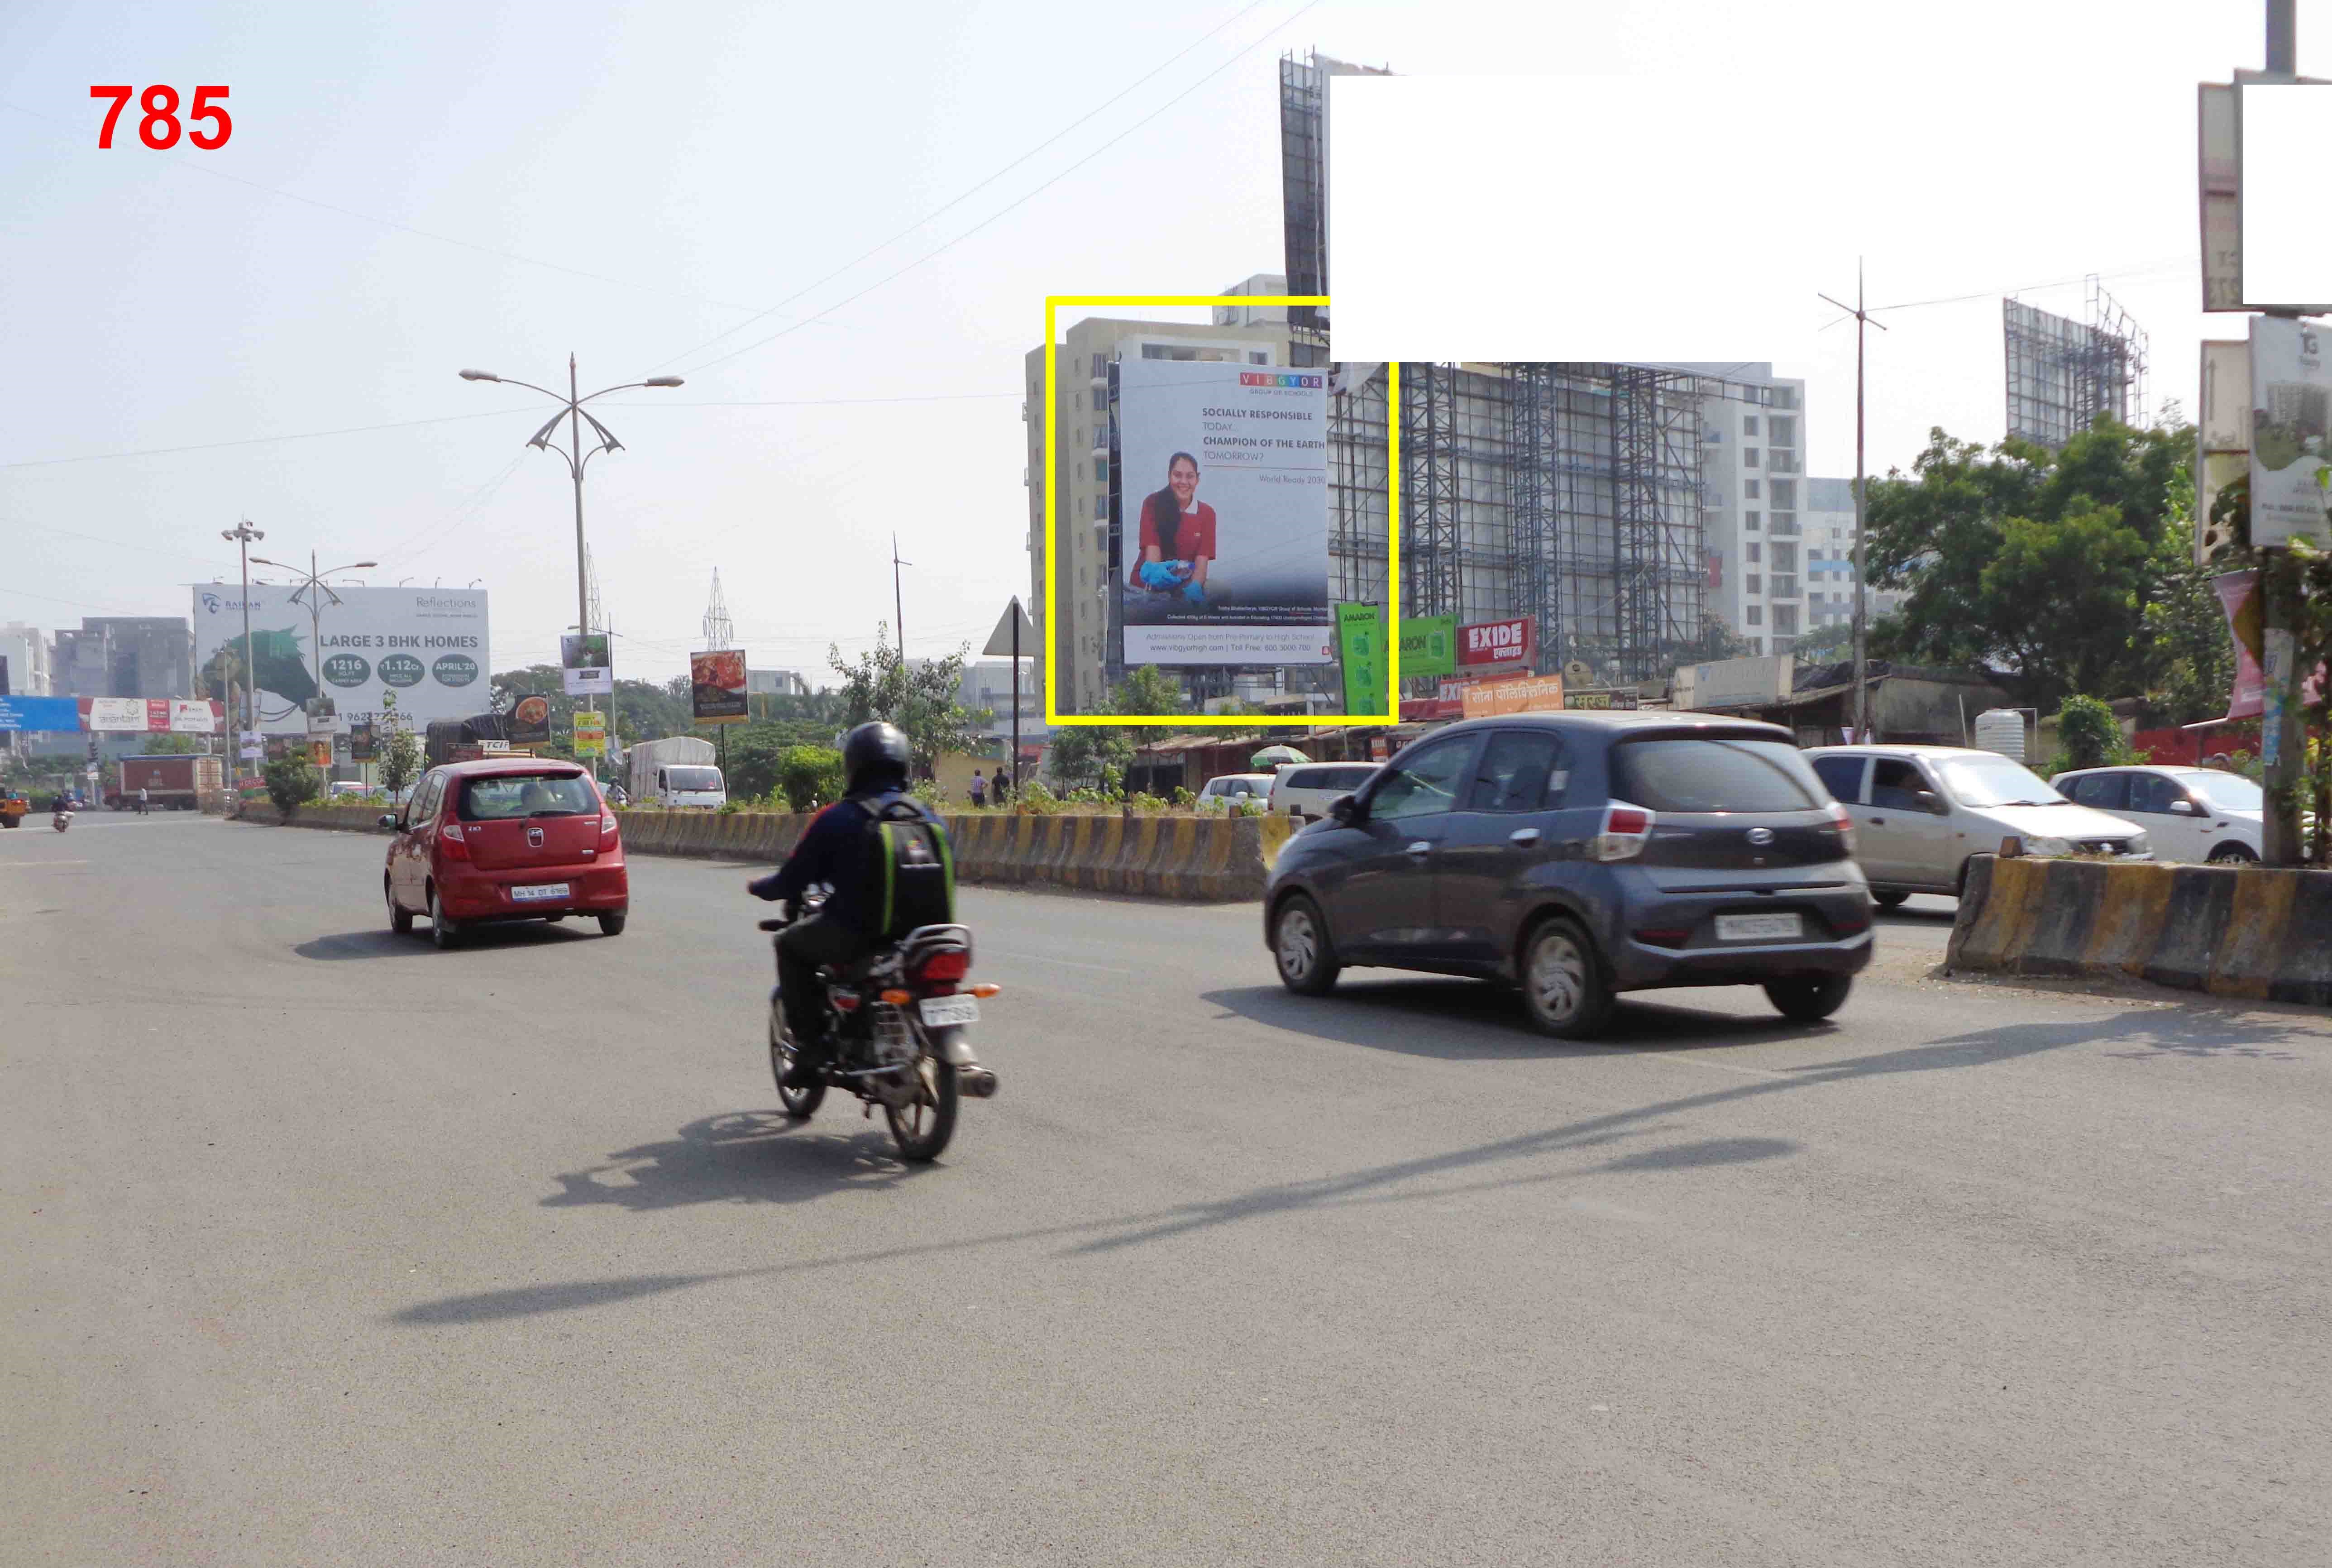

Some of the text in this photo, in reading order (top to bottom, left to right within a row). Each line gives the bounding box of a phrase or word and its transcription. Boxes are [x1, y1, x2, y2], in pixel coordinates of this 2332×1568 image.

[1242, 374, 1319, 387] VIBGYOR
[1202, 408, 1313, 421] SOCIALLY RESPONSIBLE
[1203, 436, 1325, 449] CHAMPION OF THE EARTH
[1204, 450, 1264, 461] TOMORROW?
[1259, 474, 1326, 486] World Ready 2030
[416, 597, 476, 608] Reflections
[1344, 612, 1375, 622] AMARON
[1187, 633, 1206, 641] Open
[1274, 634, 1290, 642] High
[1468, 621, 1523, 649] EXIDE
[319, 635, 478, 648] LARGE 3 BHK HOMES
[330, 659, 362, 670] 1216
